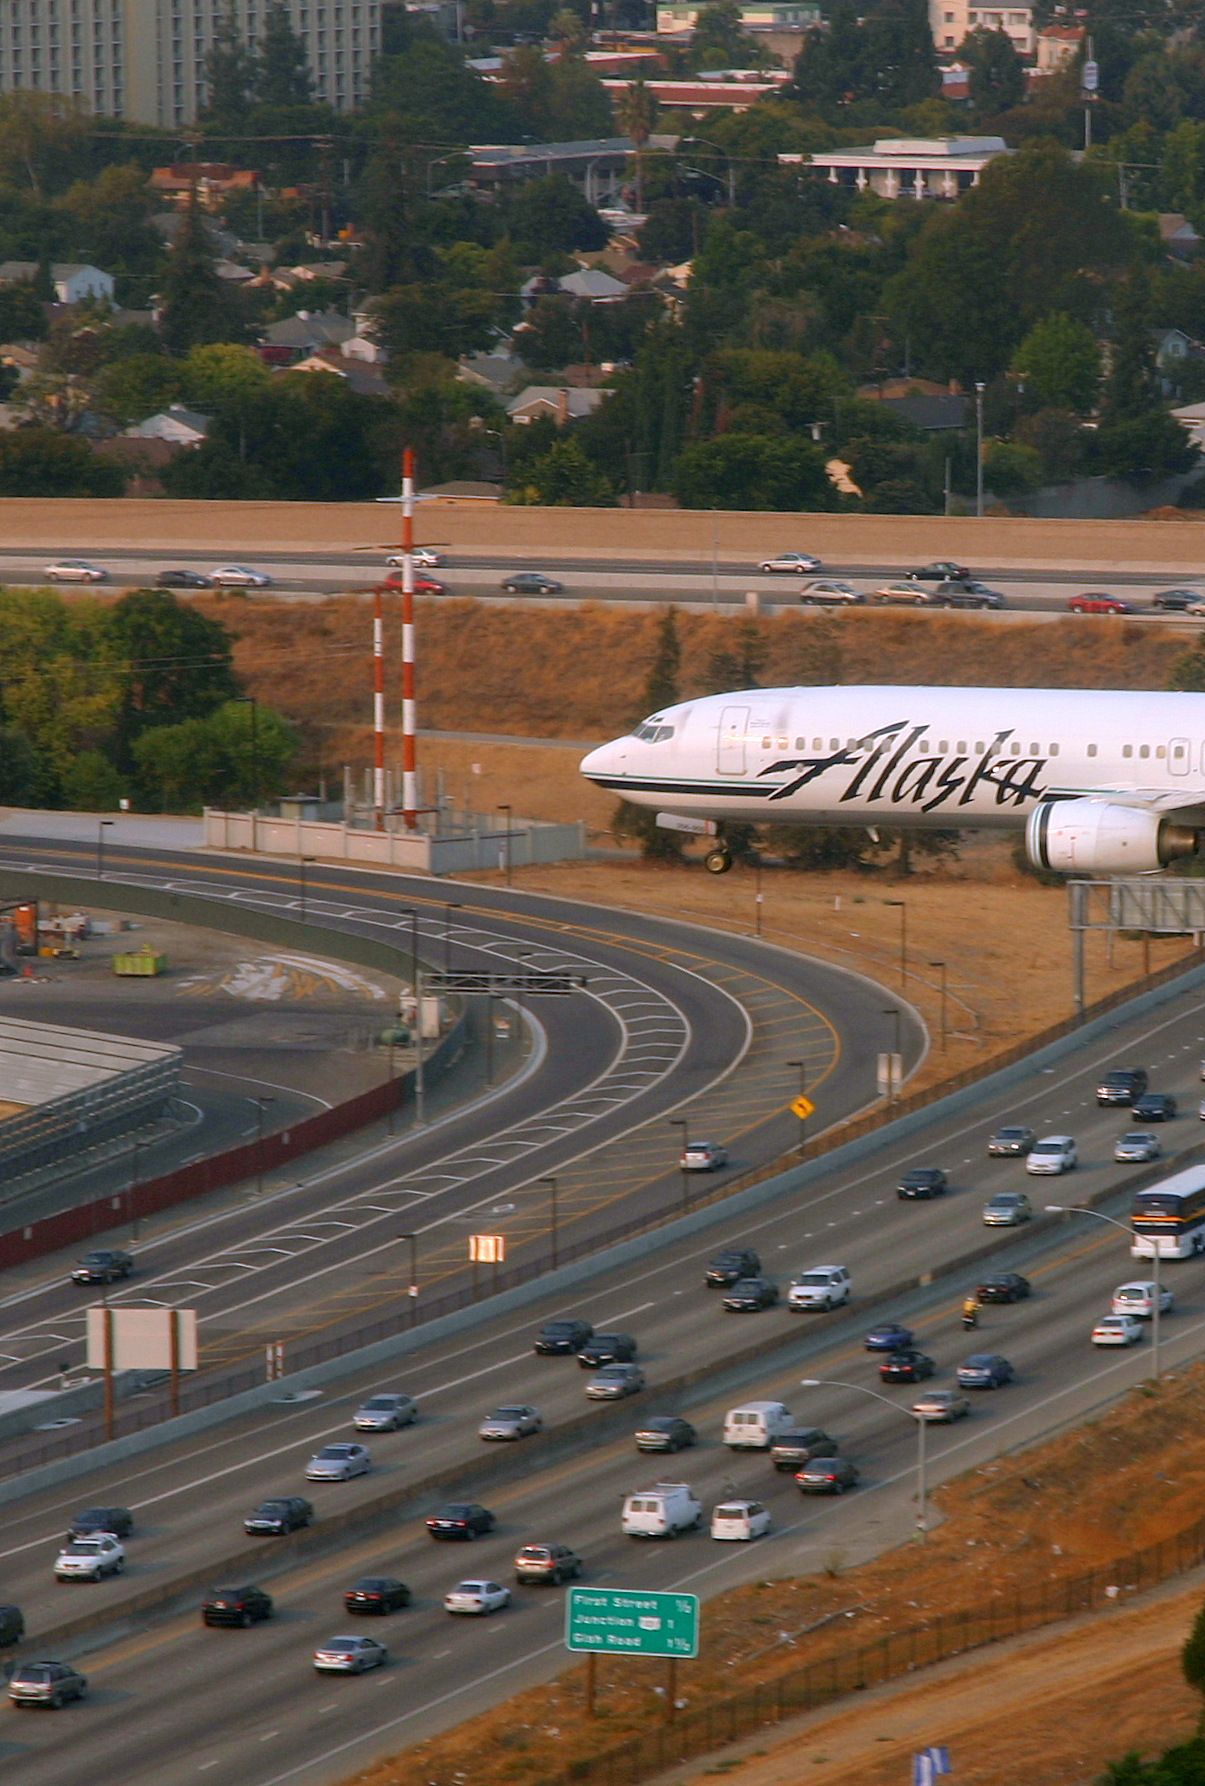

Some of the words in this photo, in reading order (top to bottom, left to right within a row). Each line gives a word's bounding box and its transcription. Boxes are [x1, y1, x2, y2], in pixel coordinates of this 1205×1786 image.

[756, 720, 1048, 814] Alaska
[574, 1594, 608, 1607] First
[613, 1597, 658, 1610] Street
[574, 1614, 635, 1627] Junction
[573, 1633, 603, 1644] Gish
[606, 1634, 641, 1647] Road
